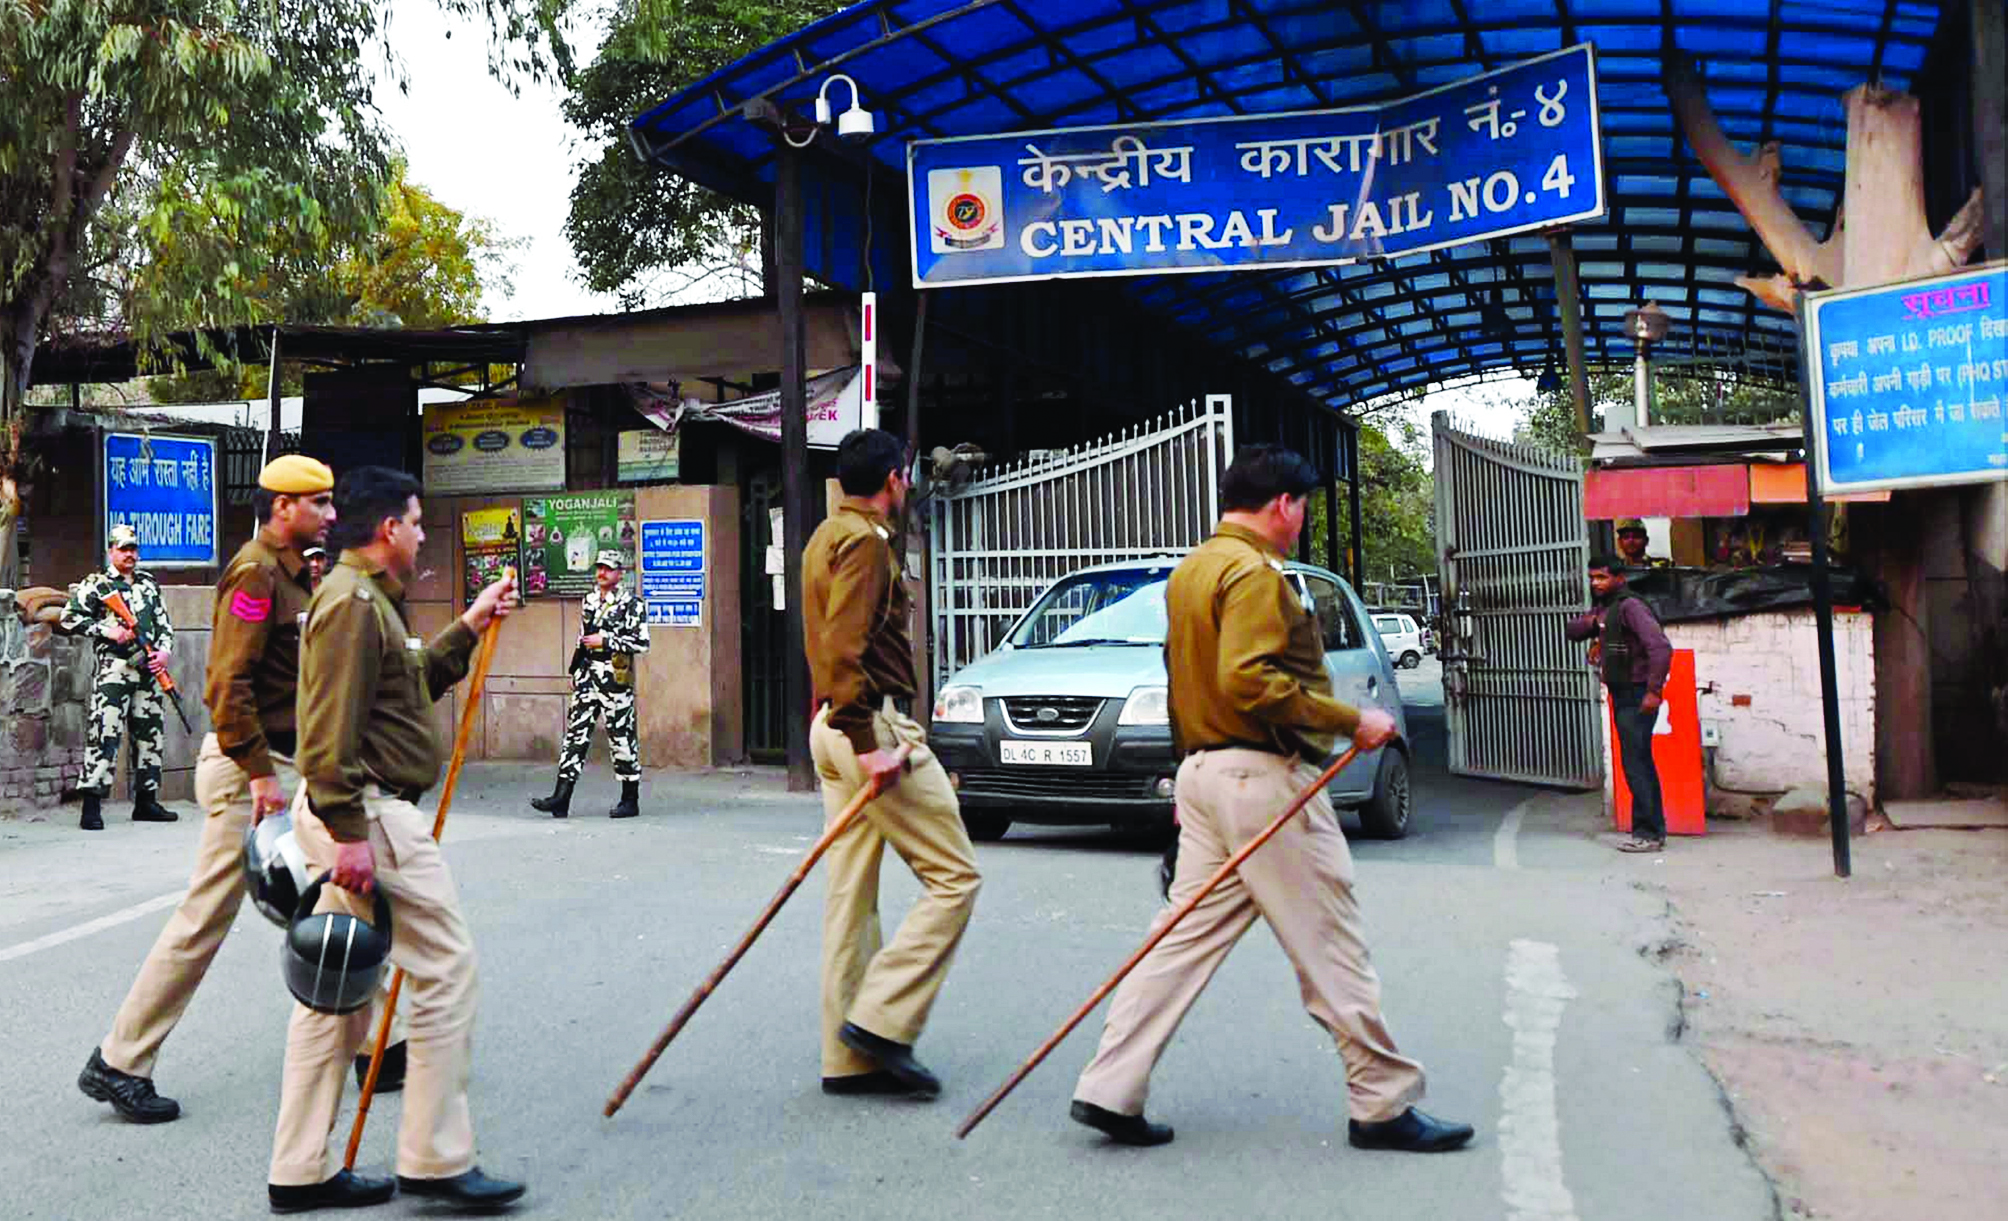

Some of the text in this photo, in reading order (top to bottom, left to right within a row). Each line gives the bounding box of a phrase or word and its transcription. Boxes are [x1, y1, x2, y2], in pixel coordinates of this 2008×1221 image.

[1018, 135, 1195, 194] केन्द्रीय
[1235, 116, 1441, 179] कारागार
[1020, 208, 1293, 258] CENTRAL
[1312, 191, 1434, 243] JAIL
[1901, 282, 1991, 320] सूचना
[1928, 323, 1973, 348] PROOF
[1833, 417, 1848, 435] पर
[109, 456, 126, 489] यह
[153, 459, 178, 488] रास्ता
[202, 450, 210, 491] है
[549, 497, 617, 511] YOGANJALI
[186, 513, 211, 546] FARE
[1044, 749, 1052, 761] R
[1060, 750, 1087, 763] 1557
